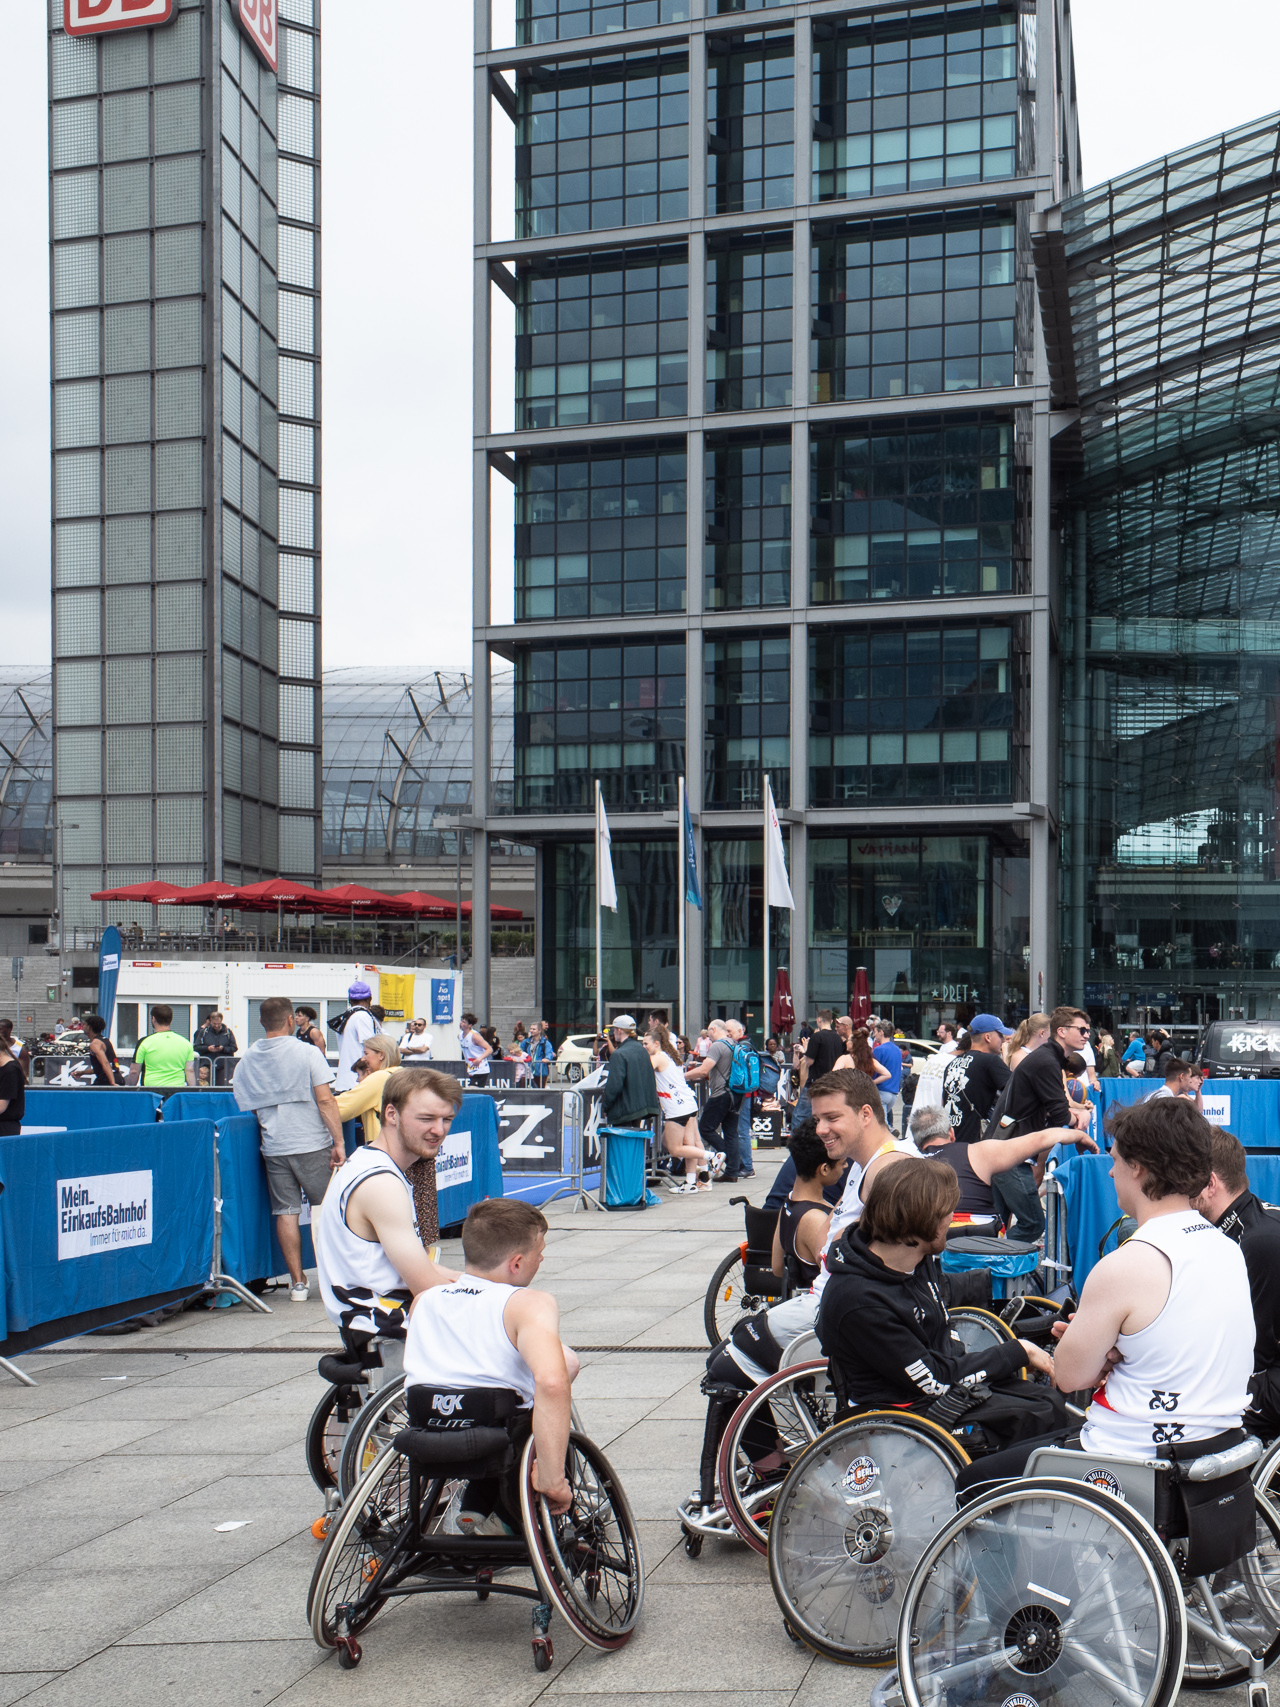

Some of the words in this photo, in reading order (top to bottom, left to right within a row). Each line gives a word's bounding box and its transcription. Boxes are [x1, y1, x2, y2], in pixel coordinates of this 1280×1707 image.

[943, 984, 969, 1002] PRET
[61, 1198, 147, 1234] EinkaufsBahnhof
[90, 1232, 111, 1247] Immer
[112, 1228, 121, 1243] für
[121, 1226, 136, 1241] mich
[137, 1224, 148, 1238] da.
[432, 1394, 465, 1416] RGK
[427, 1417, 475, 1428] ELITE
[856, 1466, 880, 1480] BERLIN
